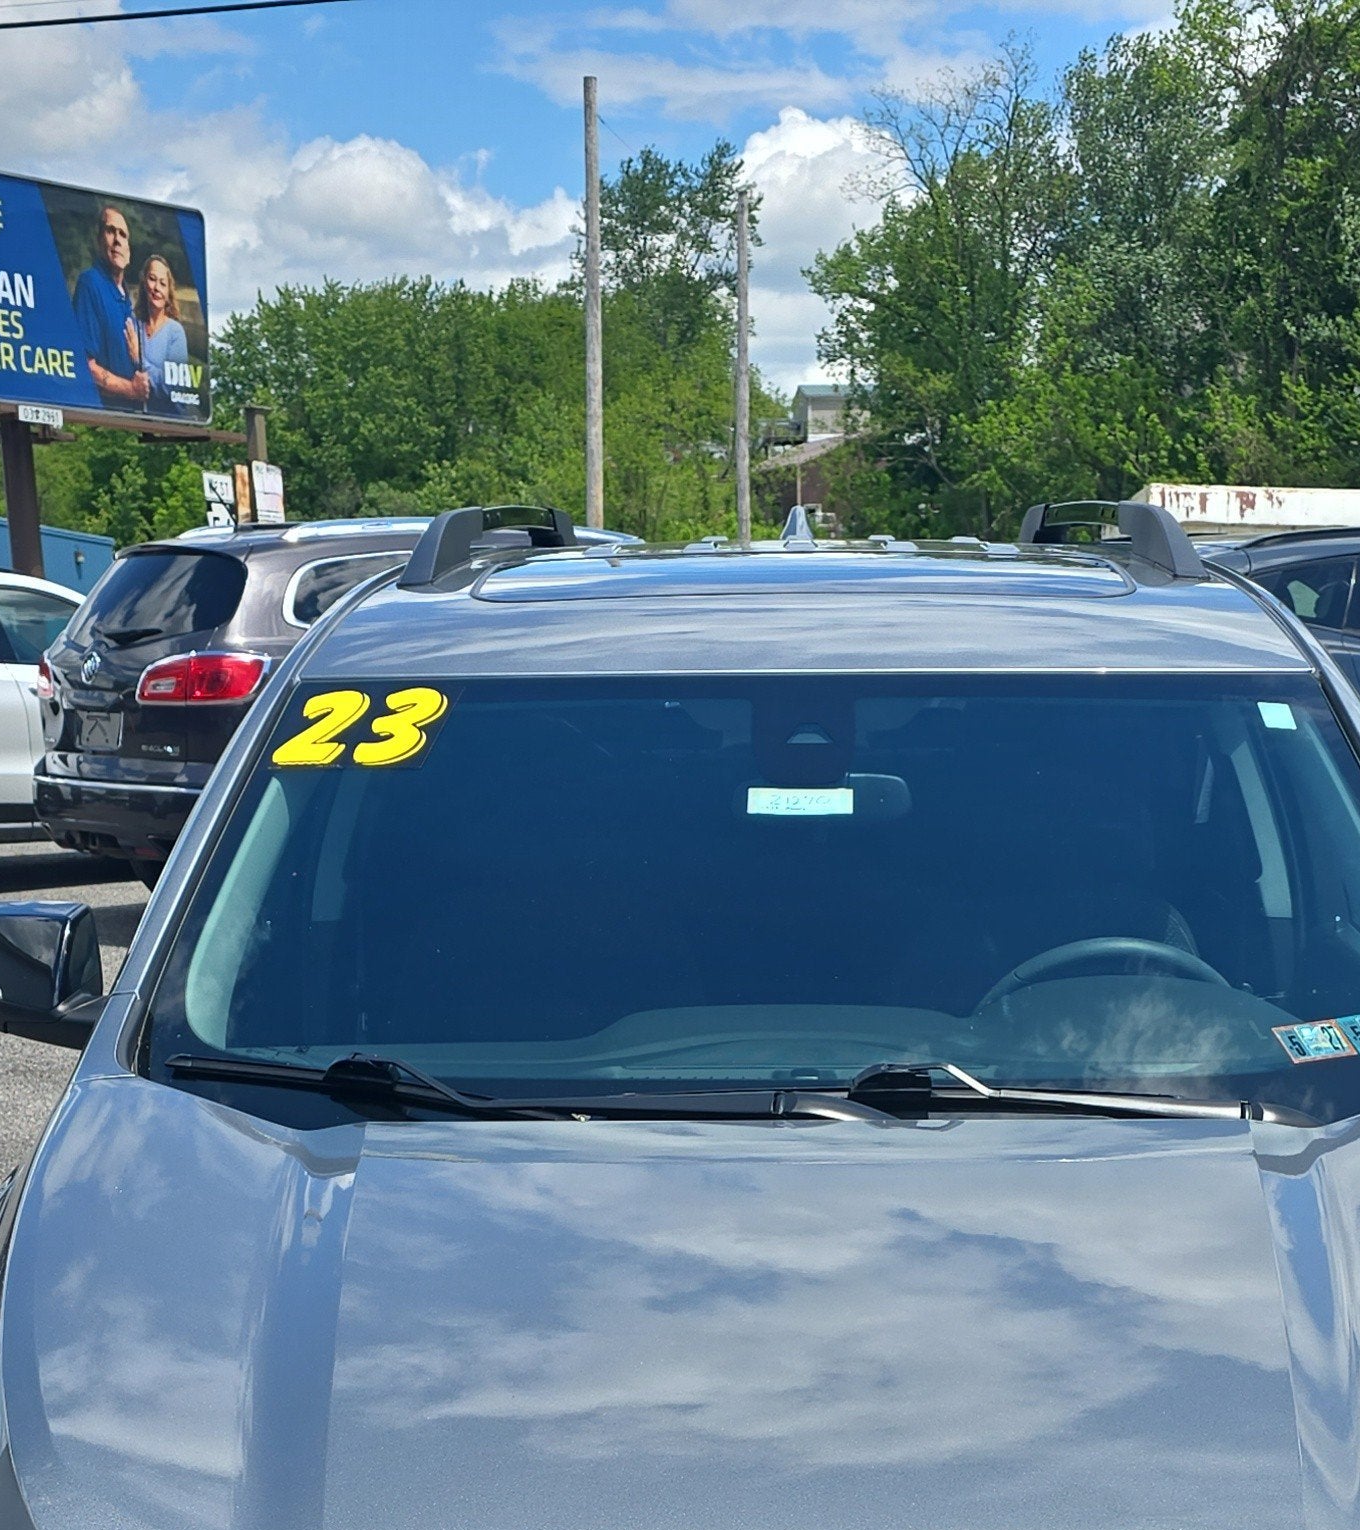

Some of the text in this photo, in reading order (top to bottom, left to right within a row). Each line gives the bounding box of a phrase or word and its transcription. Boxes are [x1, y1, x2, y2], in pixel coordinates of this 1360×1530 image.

[20, 344, 76, 379] CARE
[164, 361, 203, 388] DAV
[272, 687, 448, 766] 23
[1321, 1025, 1346, 1052] 27
